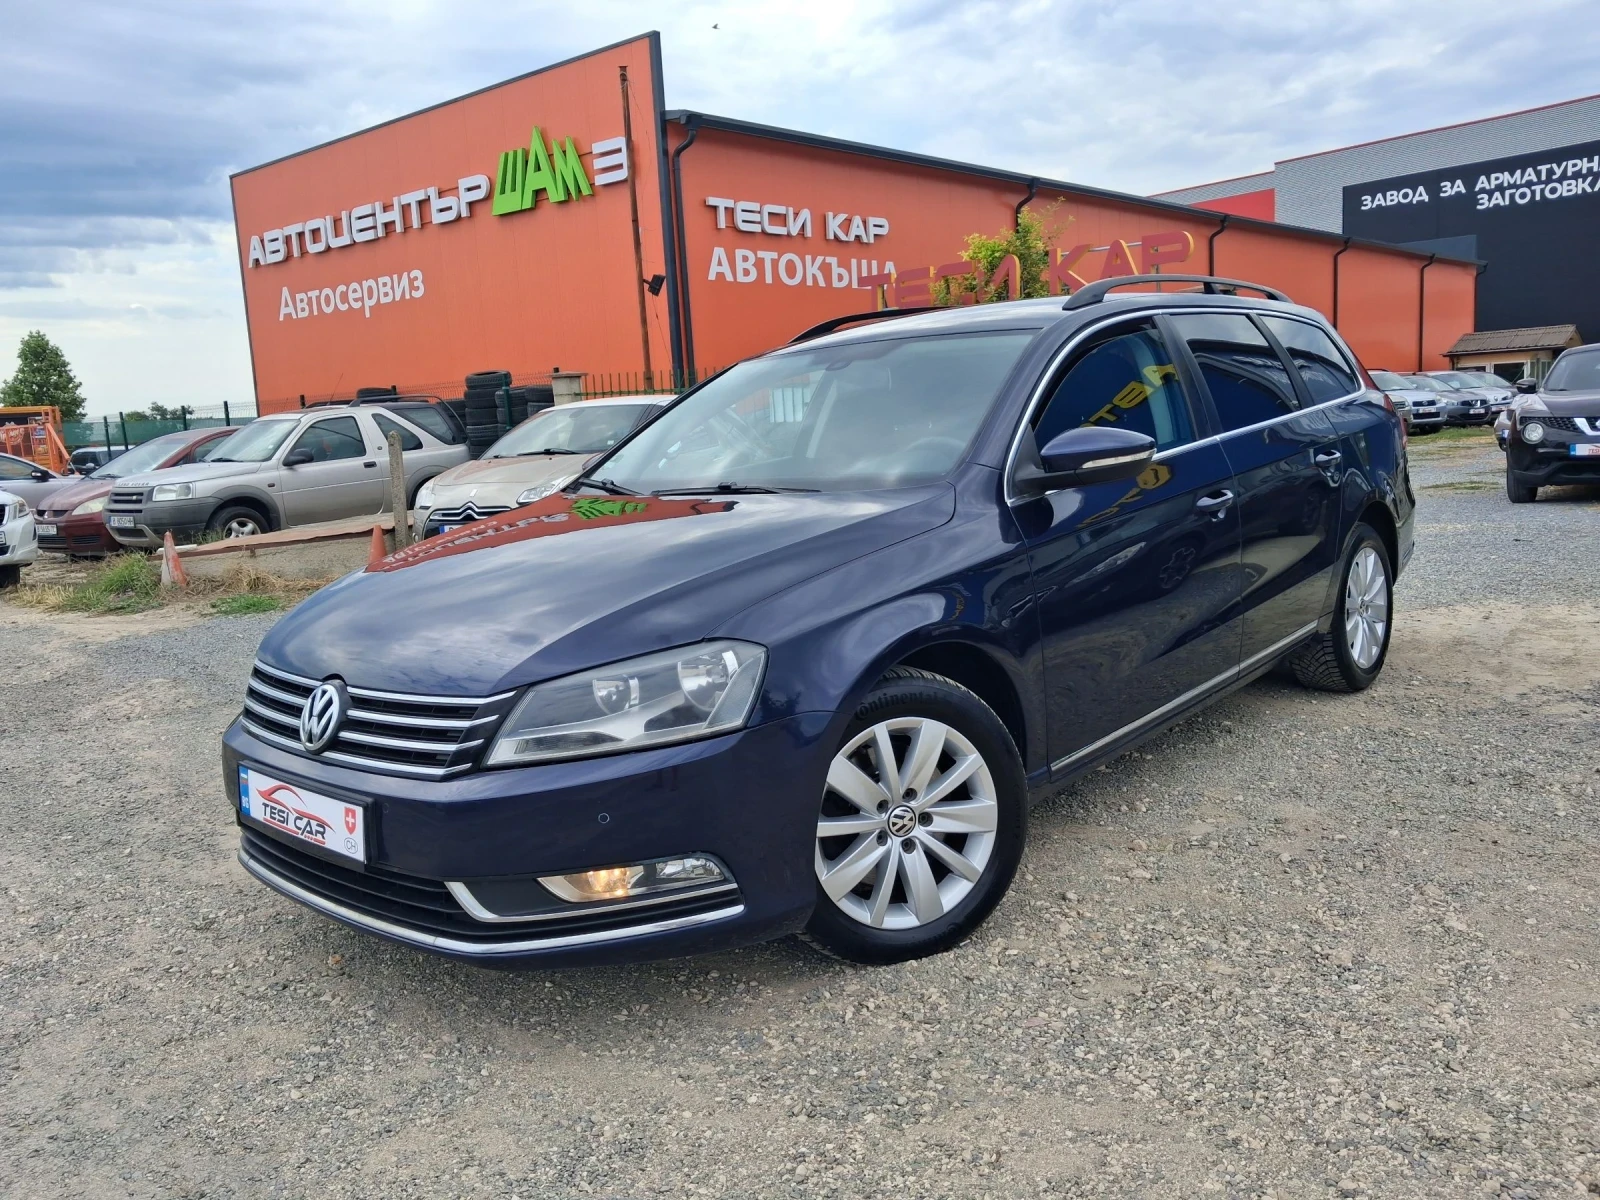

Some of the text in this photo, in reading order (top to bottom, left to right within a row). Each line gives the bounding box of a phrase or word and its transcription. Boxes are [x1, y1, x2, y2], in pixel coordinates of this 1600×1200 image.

[1360, 155, 1600, 211] ЗАВОД ЗА АРМАТУРН
[248, 173, 491, 269] АВТОЦЕНТЪР
[705, 196, 889, 244] ТЕСИ КАР
[1048, 230, 1195, 295] КАР
[278, 269, 425, 322] Автосервиз
[262, 802, 326, 840] TESI CAR
